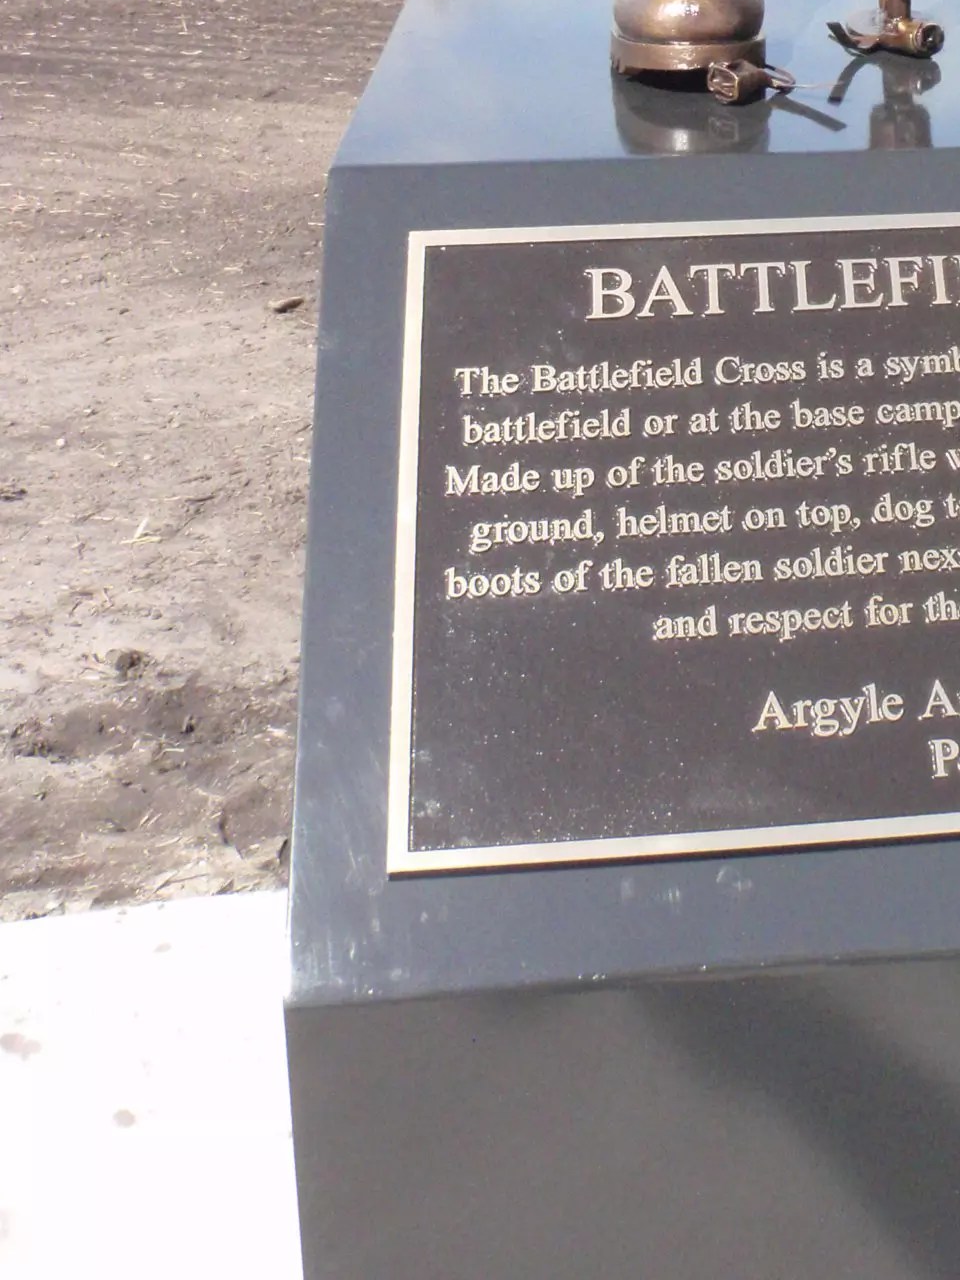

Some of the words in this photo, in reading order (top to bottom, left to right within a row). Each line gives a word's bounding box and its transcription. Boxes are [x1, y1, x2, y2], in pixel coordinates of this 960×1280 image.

[456, 367, 519, 396] The
[528, 357, 703, 395] Battlefield
[714, 356, 806, 386] Cross
[817, 352, 844, 381] is
[854, 358, 875, 376] a
[461, 407, 631, 447] battlefield
[642, 414, 678, 438] or
[688, 408, 719, 435] at
[728, 401, 781, 434] the
[789, 398, 864, 429] base
[444, 461, 540, 497] Made
[550, 467, 594, 499] up
[605, 456, 645, 488] of
[650, 454, 704, 486] the
[714, 447, 853, 484] soldier's
[862, 442, 936, 475] rifle
[468, 508, 604, 555] ground,
[616, 505, 732, 539] helmet
[741, 508, 787, 531] on
[795, 501, 861, 534] top,
[871, 492, 935, 529] dog
[444, 565, 543, 601] boots
[546, 560, 593, 595] of
[598, 558, 656, 592] the
[665, 550, 764, 588] fallen
[773, 545, 889, 581] soldier
[652, 605, 718, 641] and
[728, 601, 853, 641] respect
[864, 594, 913, 628] for
[751, 683, 904, 737] Argyle
